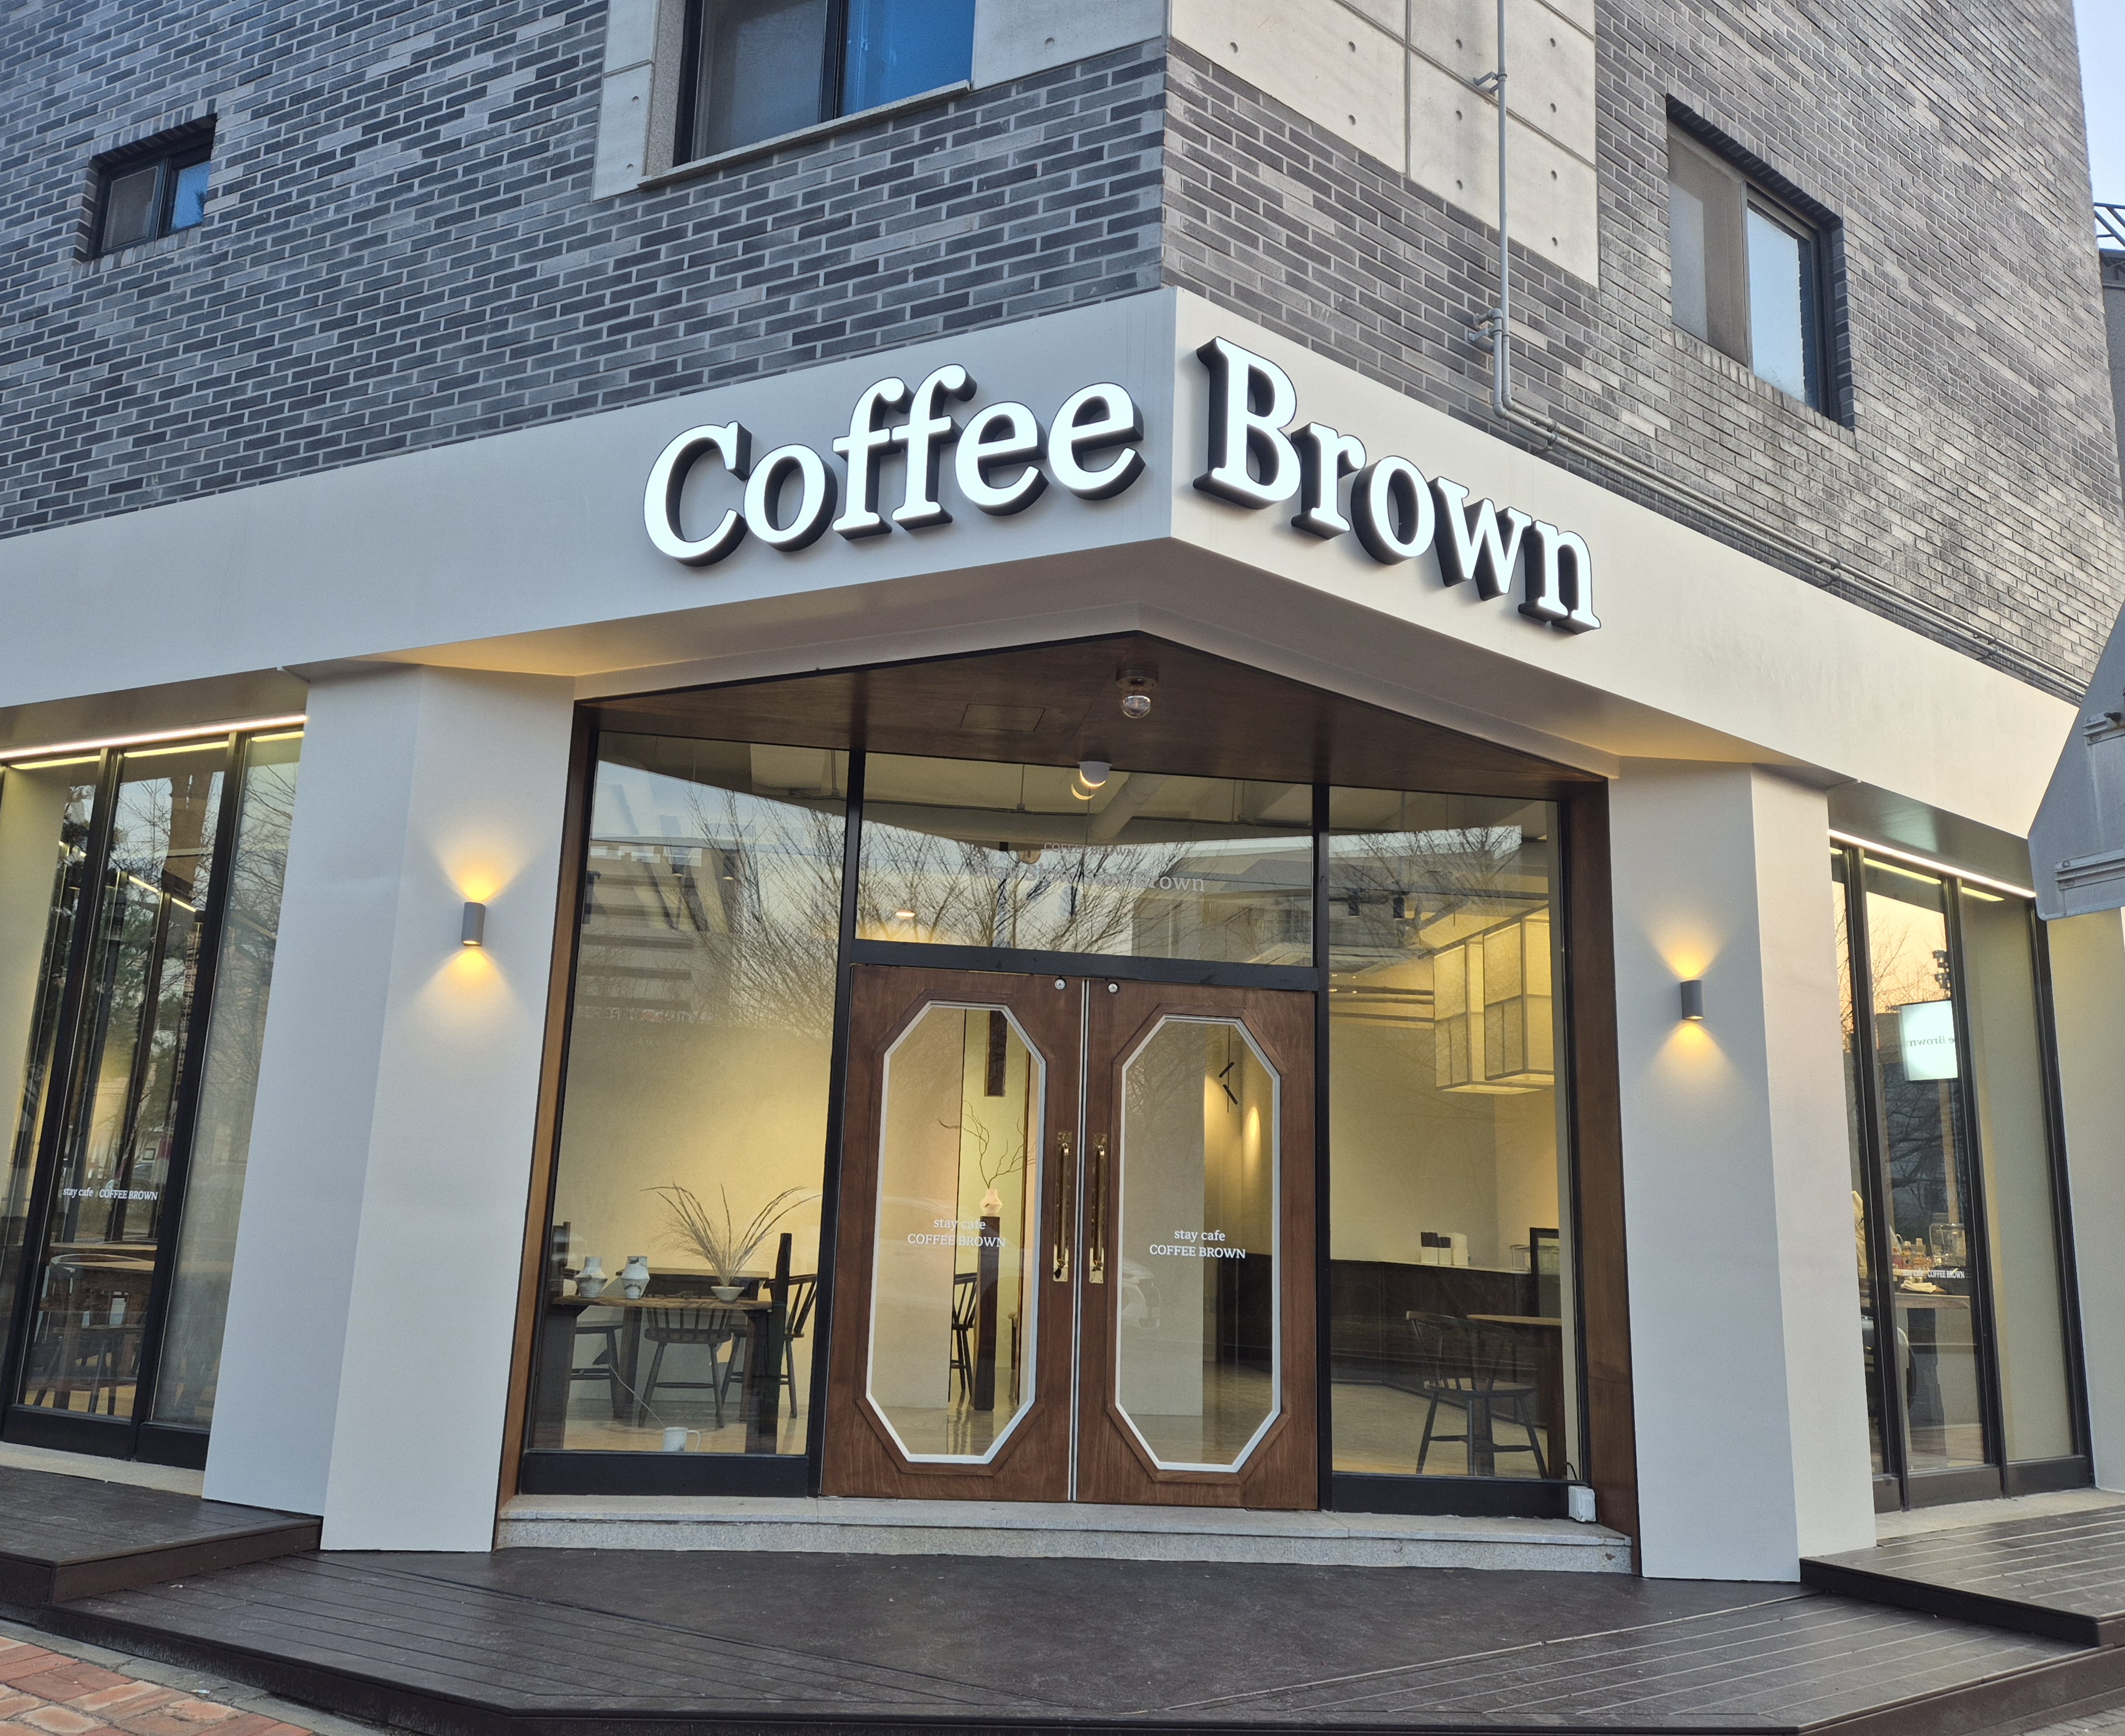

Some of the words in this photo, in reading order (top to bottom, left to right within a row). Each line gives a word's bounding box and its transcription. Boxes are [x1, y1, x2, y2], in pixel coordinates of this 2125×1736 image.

[643, 363, 1145, 566] Coffee
[1193, 336, 1601, 633] Brown
[1044, 842, 1089, 855] COFFEE
[1091, 845, 1137, 857] BROWN
[973, 861, 1019, 884] Stay
[1084, 868, 1129, 893] Stay
[1135, 870, 1205, 892] Brown
[62, 1188, 78, 1198] stay
[78, 1187, 94, 1197] cafe
[99, 1189, 128, 1199] COFFEE
[128, 1191, 158, 1201] BROWN
[934, 1219, 957, 1231] stay
[961, 1219, 986, 1230] cafe
[908, 1233, 956, 1246] COFFEE
[958, 1236, 1007, 1248] BROWN
[1174, 1230, 1198, 1243] stay
[1201, 1230, 1226, 1242] cafe
[1150, 1244, 1196, 1257] COFFEE
[1199, 1246, 1246, 1259] BROWN
[1927, 1269, 1946, 1278] COFFEE
[1946, 1270, 1965, 1279] BROWN
